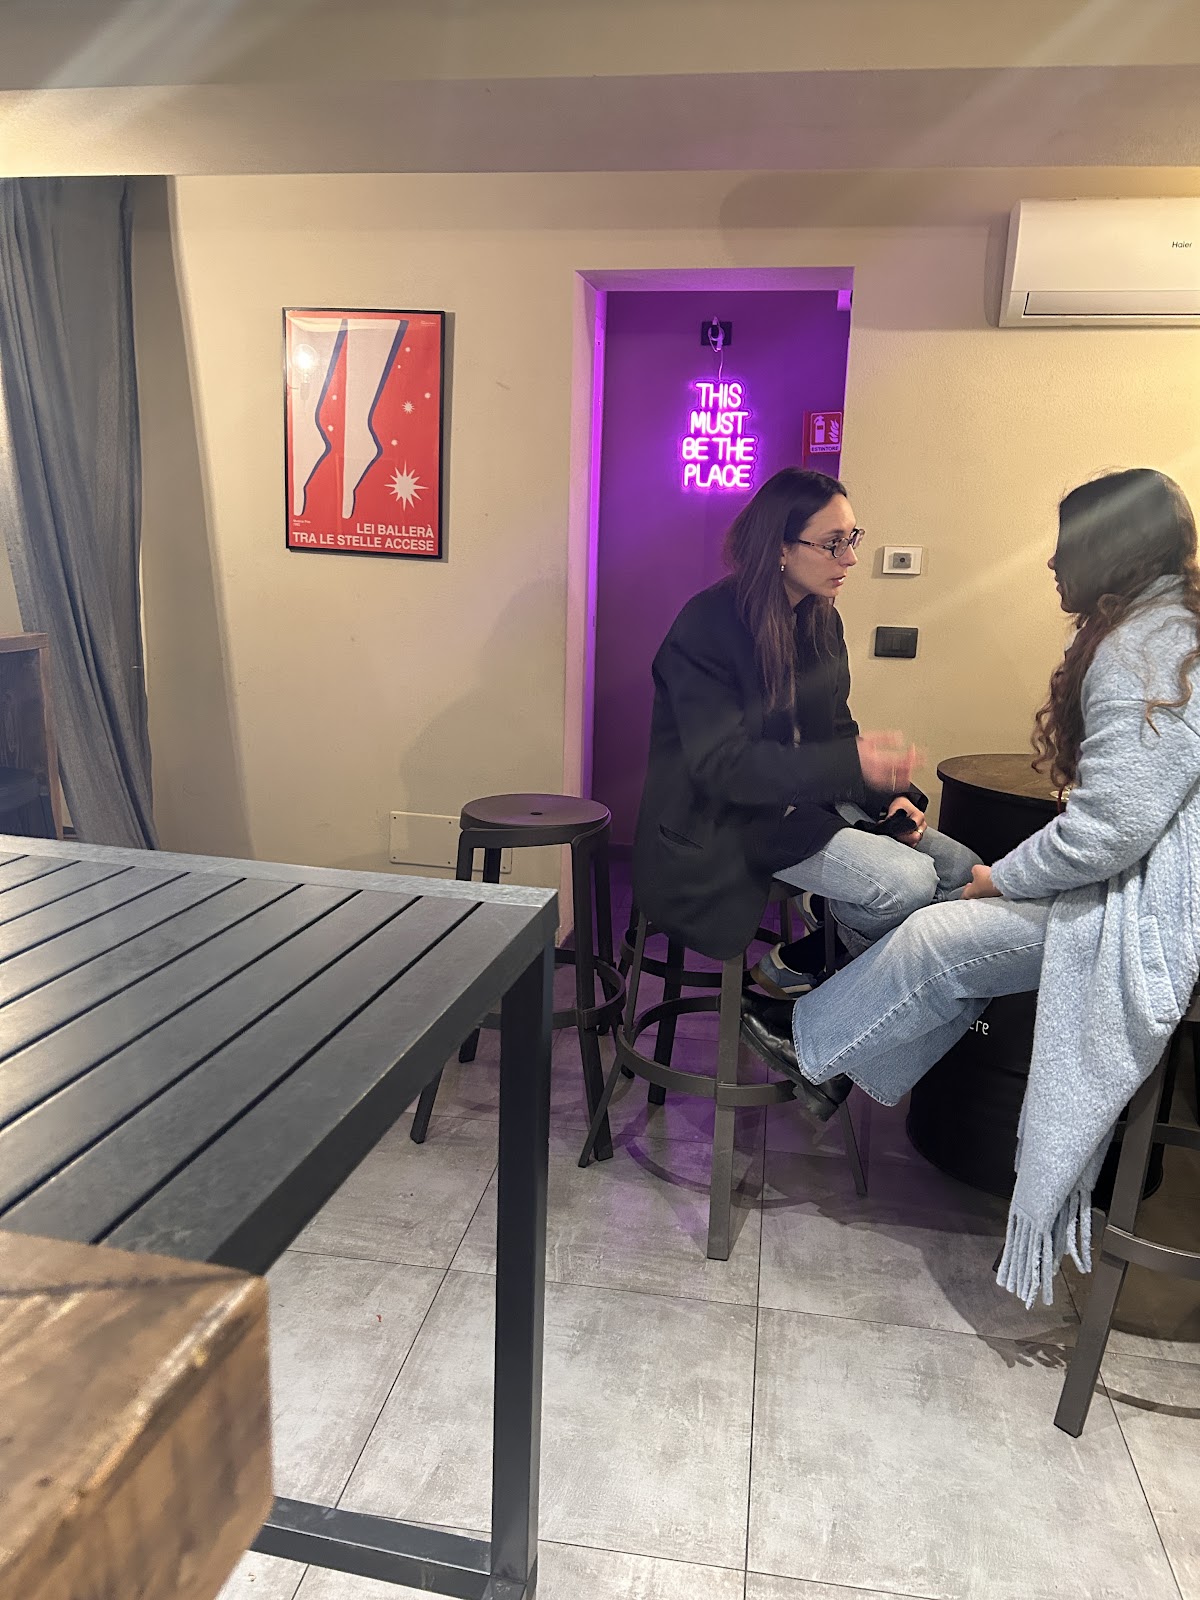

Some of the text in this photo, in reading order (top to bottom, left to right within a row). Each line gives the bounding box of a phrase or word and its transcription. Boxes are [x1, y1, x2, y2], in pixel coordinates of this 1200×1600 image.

[695, 382, 743, 409] THIS
[690, 410, 749, 435] MUST
[682, 437, 755, 461] BE THE
[683, 463, 751, 488] PLACE
[292, 531, 435, 552] TRA LE STELLE ACCESE
[356, 522, 434, 538] LEI BALLERÀ
